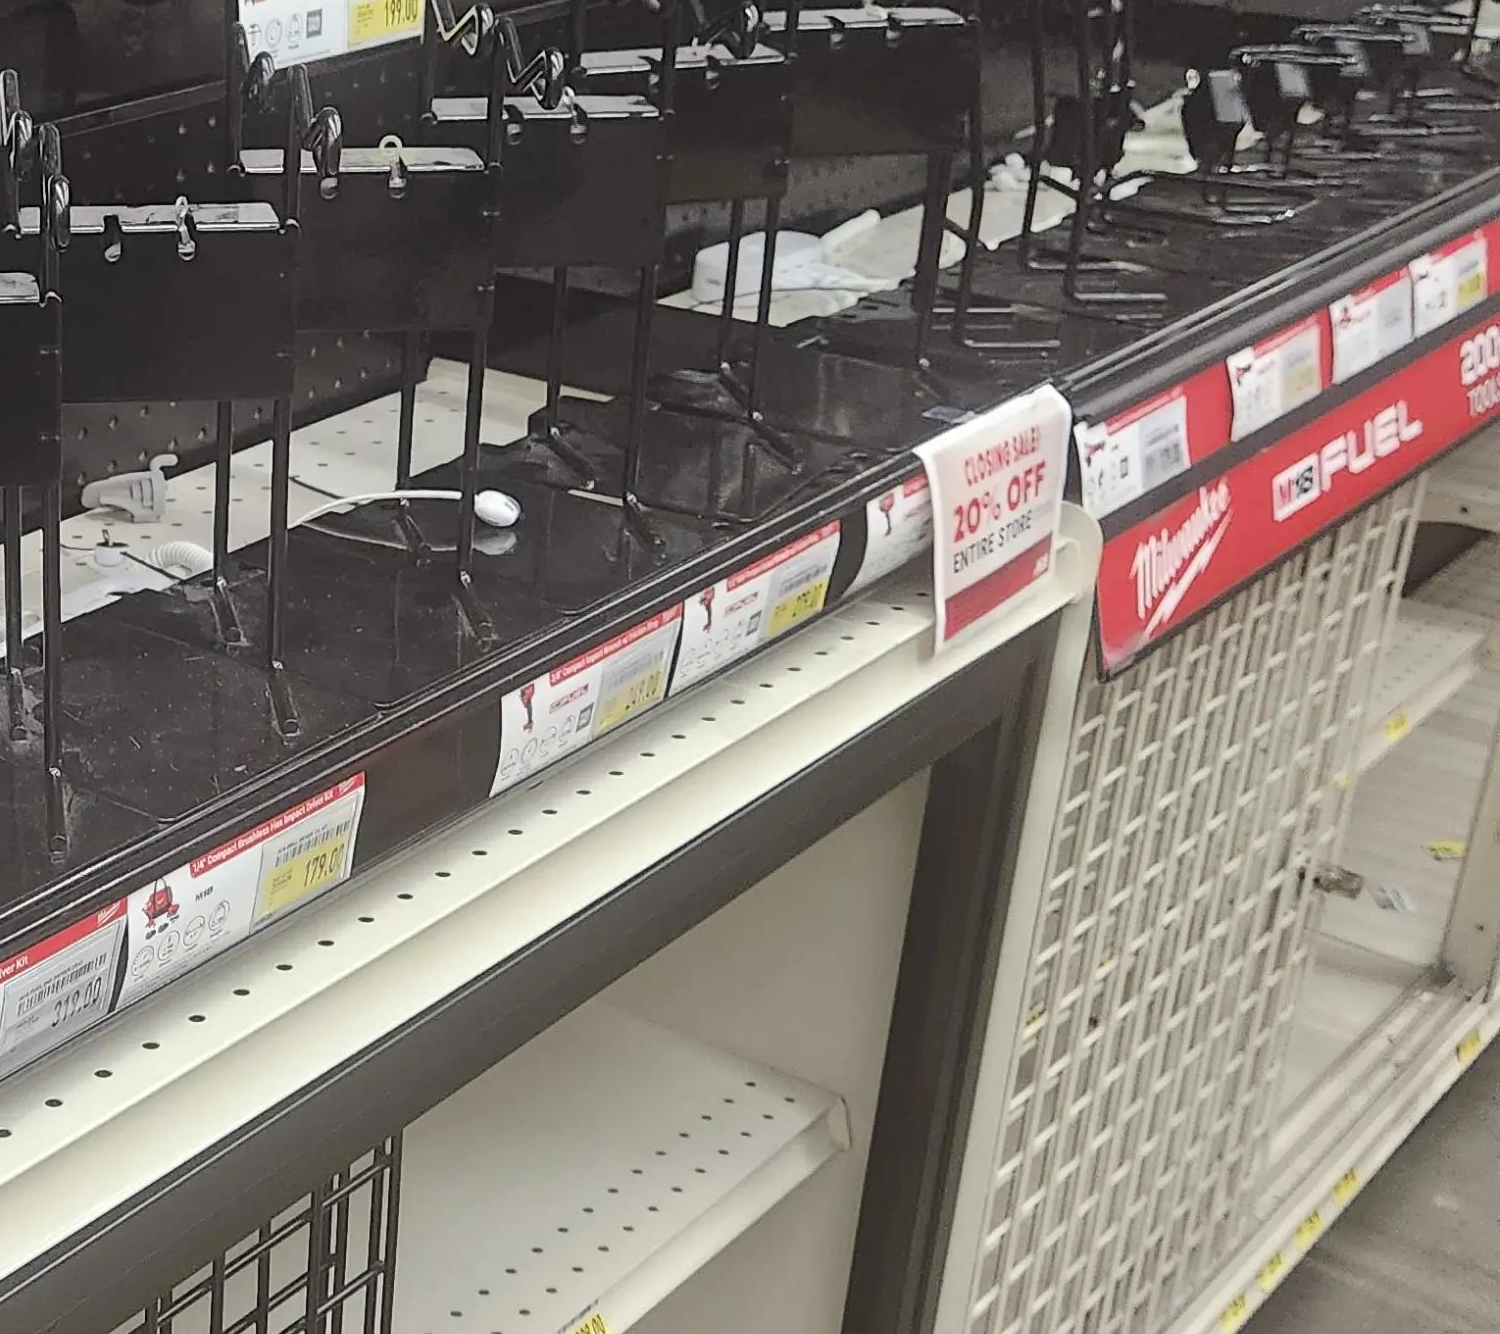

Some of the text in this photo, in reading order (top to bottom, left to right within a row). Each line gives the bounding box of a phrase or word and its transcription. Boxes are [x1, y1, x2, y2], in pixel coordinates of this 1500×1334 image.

[964, 424, 1042, 487] CLOSING SALE!
[1321, 399, 1424, 493] FUEL
[953, 459, 1046, 543] 20% OFF
[953, 509, 1033, 575] ENTIRE STORE
[1130, 476, 1231, 620] Milwaukee
[207, 842, 239, 866] Compact
[238, 825, 271, 850] Brushless
[284, 807, 307, 825] Impact
[303, 842, 346, 888] 179.00
[15, 953, 30, 971] Kit
[51, 976, 102, 1028] 319.00
